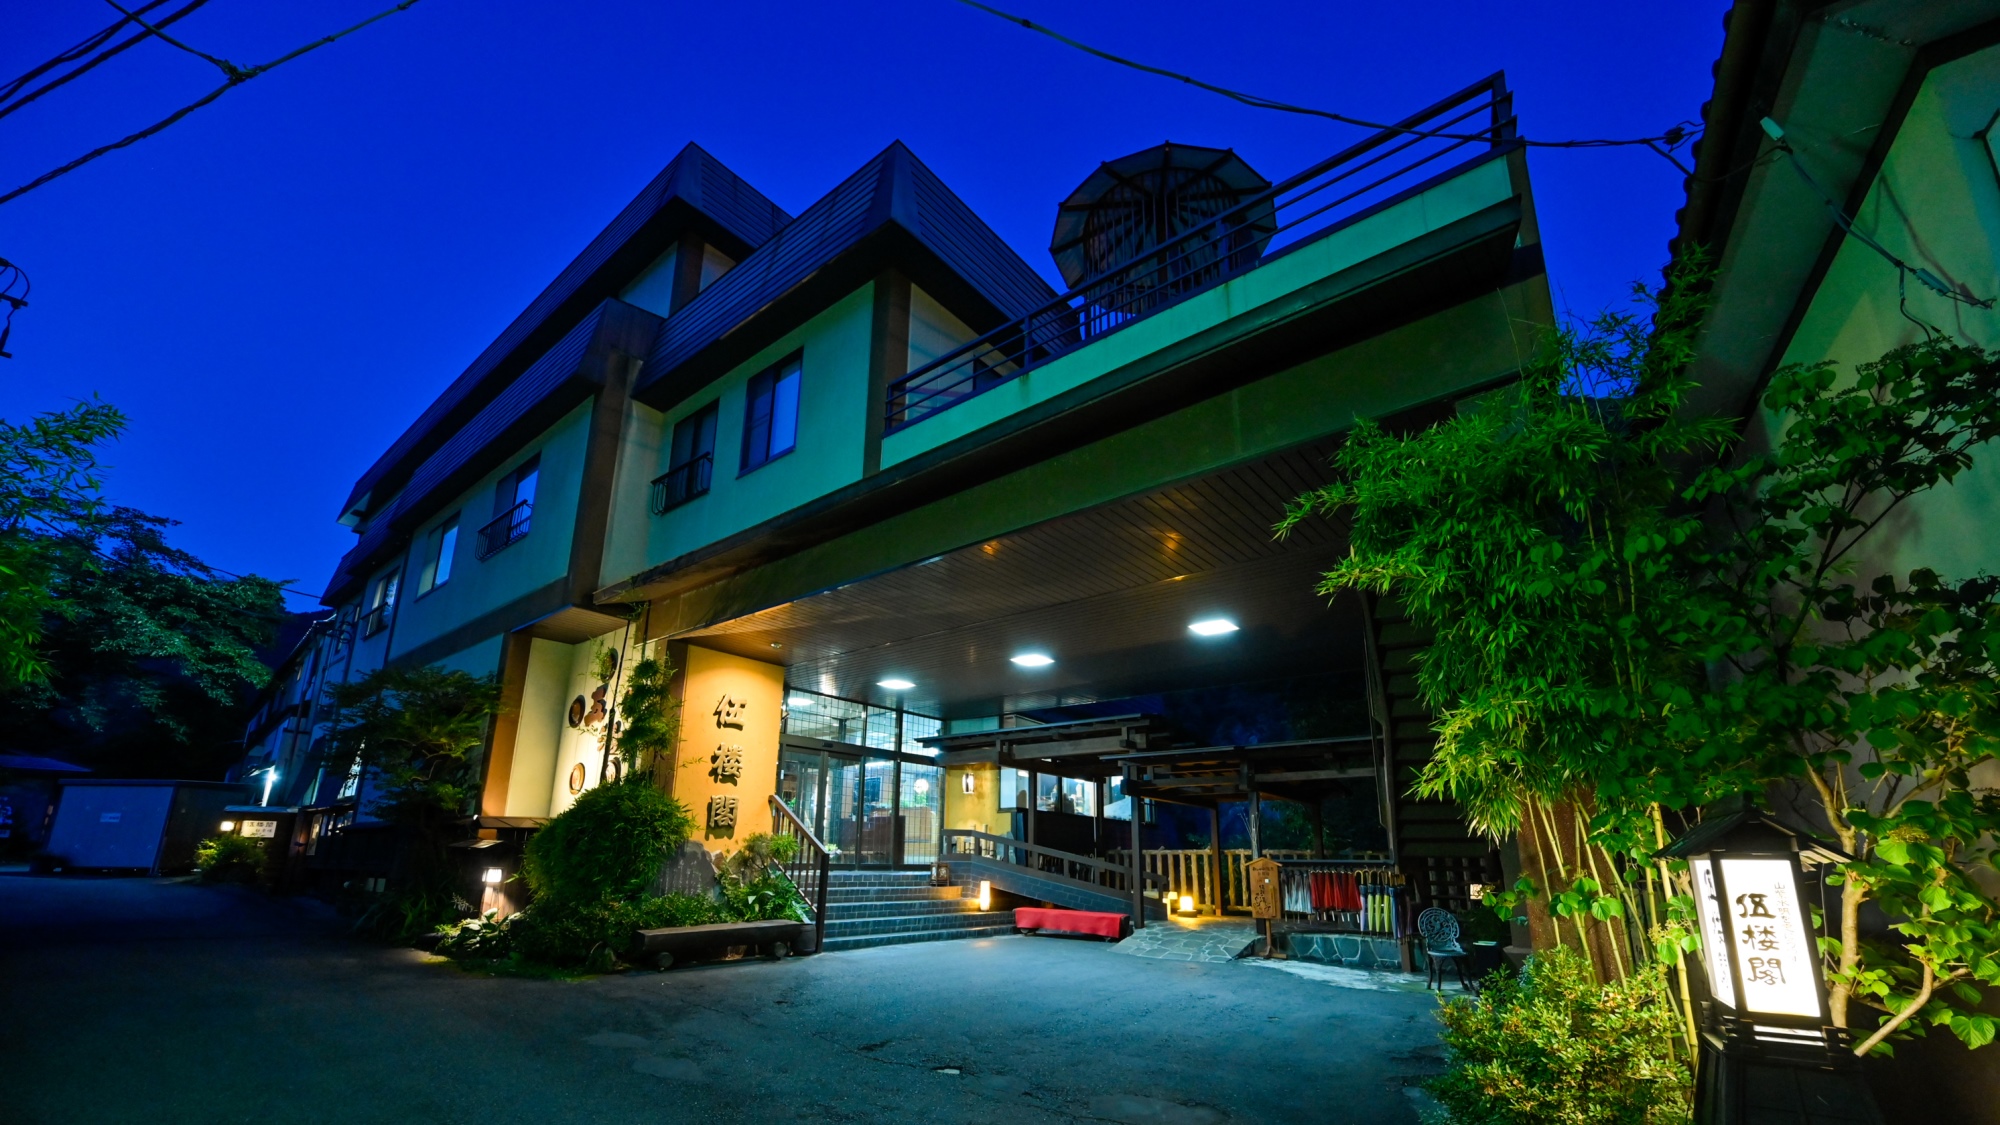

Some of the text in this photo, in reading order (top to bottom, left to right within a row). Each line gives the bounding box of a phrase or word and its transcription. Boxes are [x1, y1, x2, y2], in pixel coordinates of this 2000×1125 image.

[708, 693, 748, 829] 伍楼閣
[1736, 893, 1786, 986] 伍楼閣
